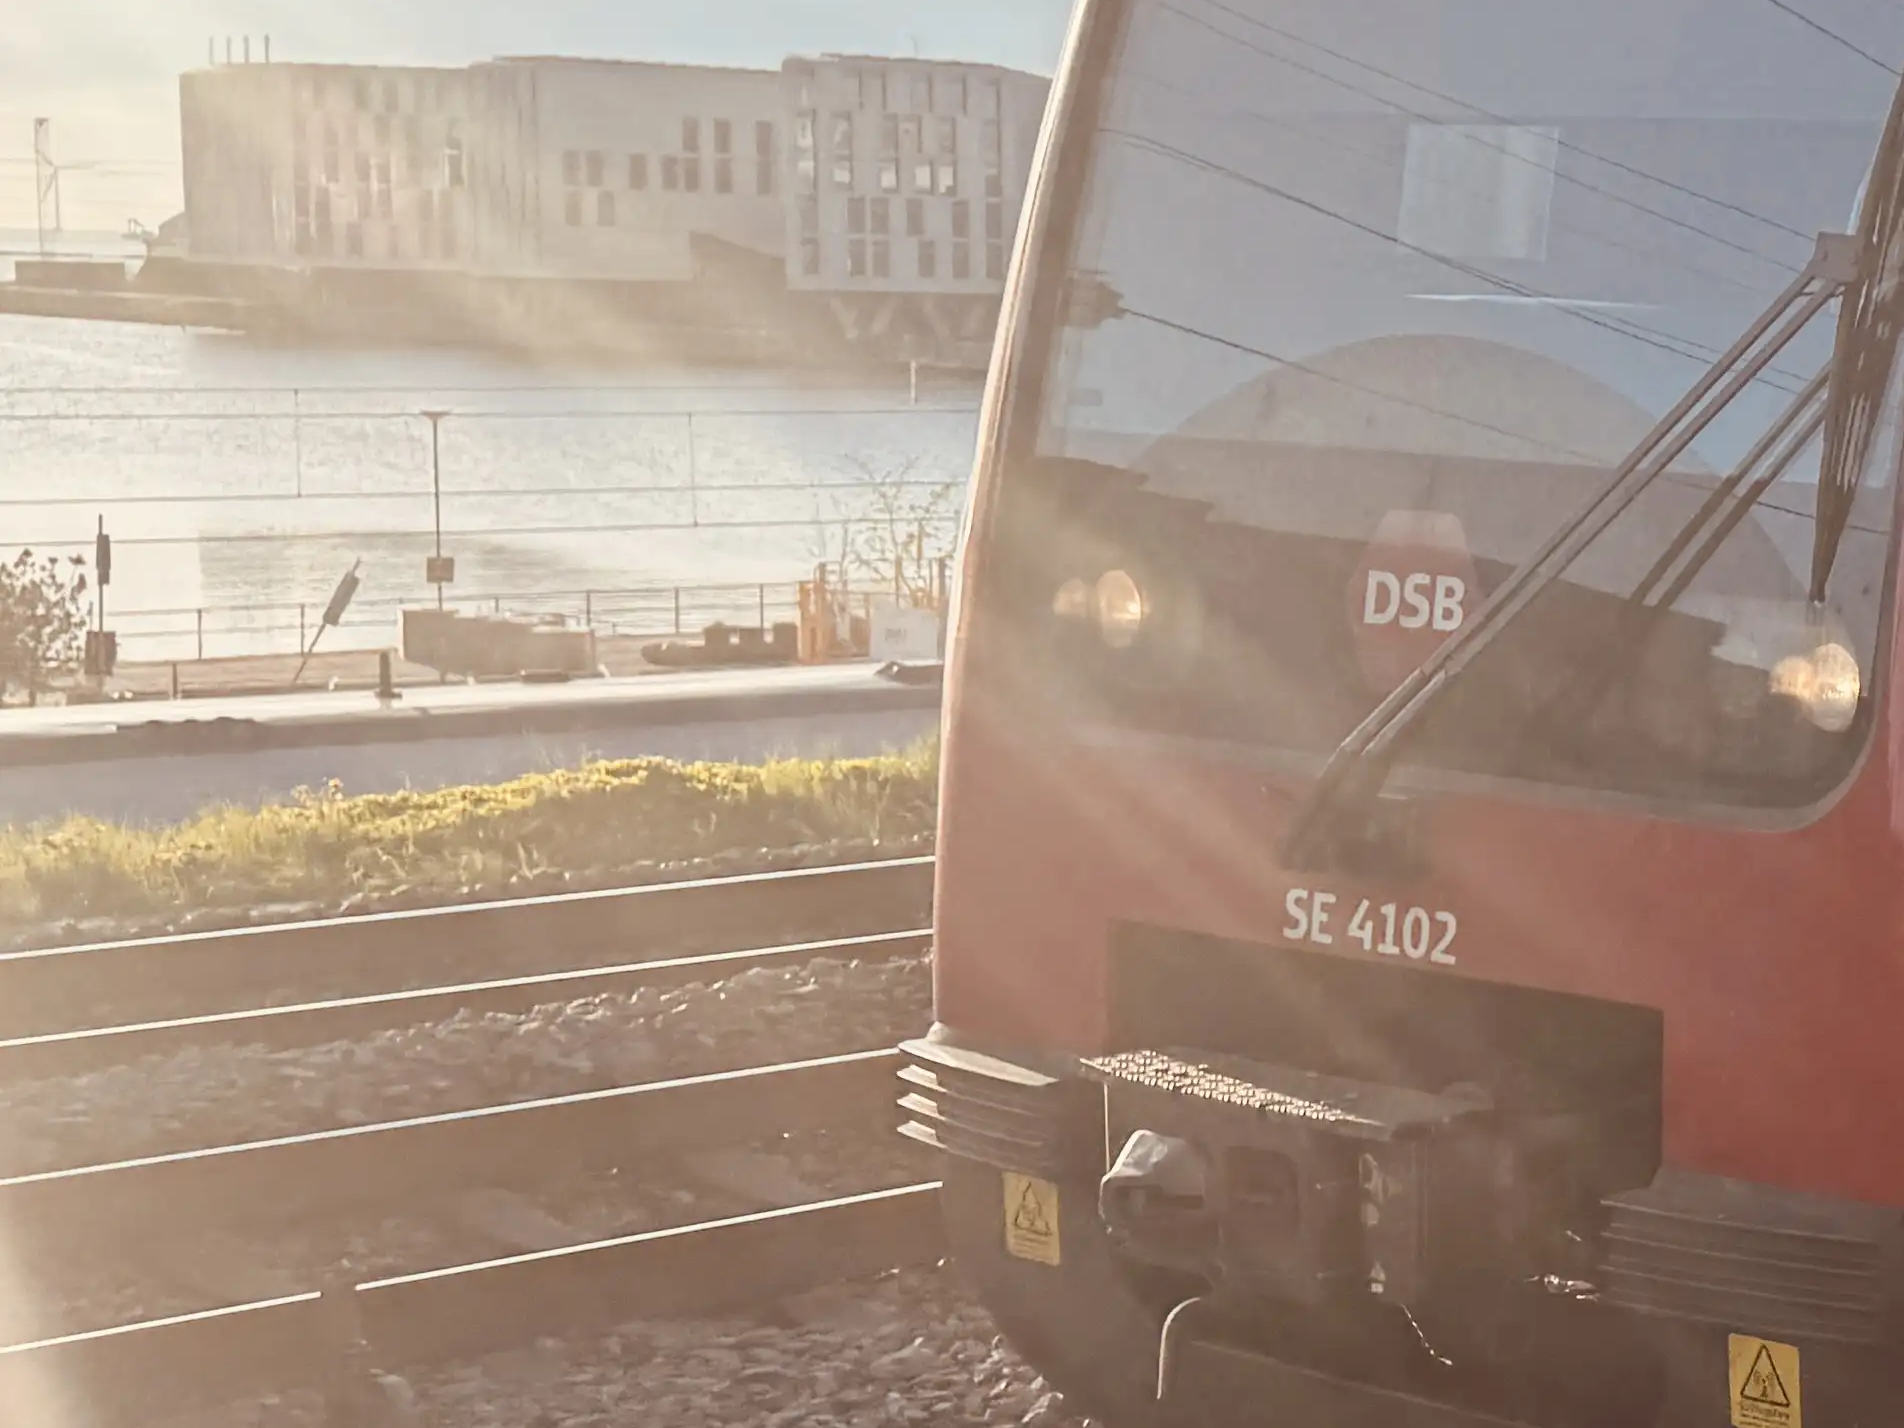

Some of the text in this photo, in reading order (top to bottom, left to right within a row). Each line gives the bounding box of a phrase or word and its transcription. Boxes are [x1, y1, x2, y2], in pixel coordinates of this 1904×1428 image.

[1363, 569, 1466, 631] DSB
[1282, 888, 1457, 965] SE 4102
